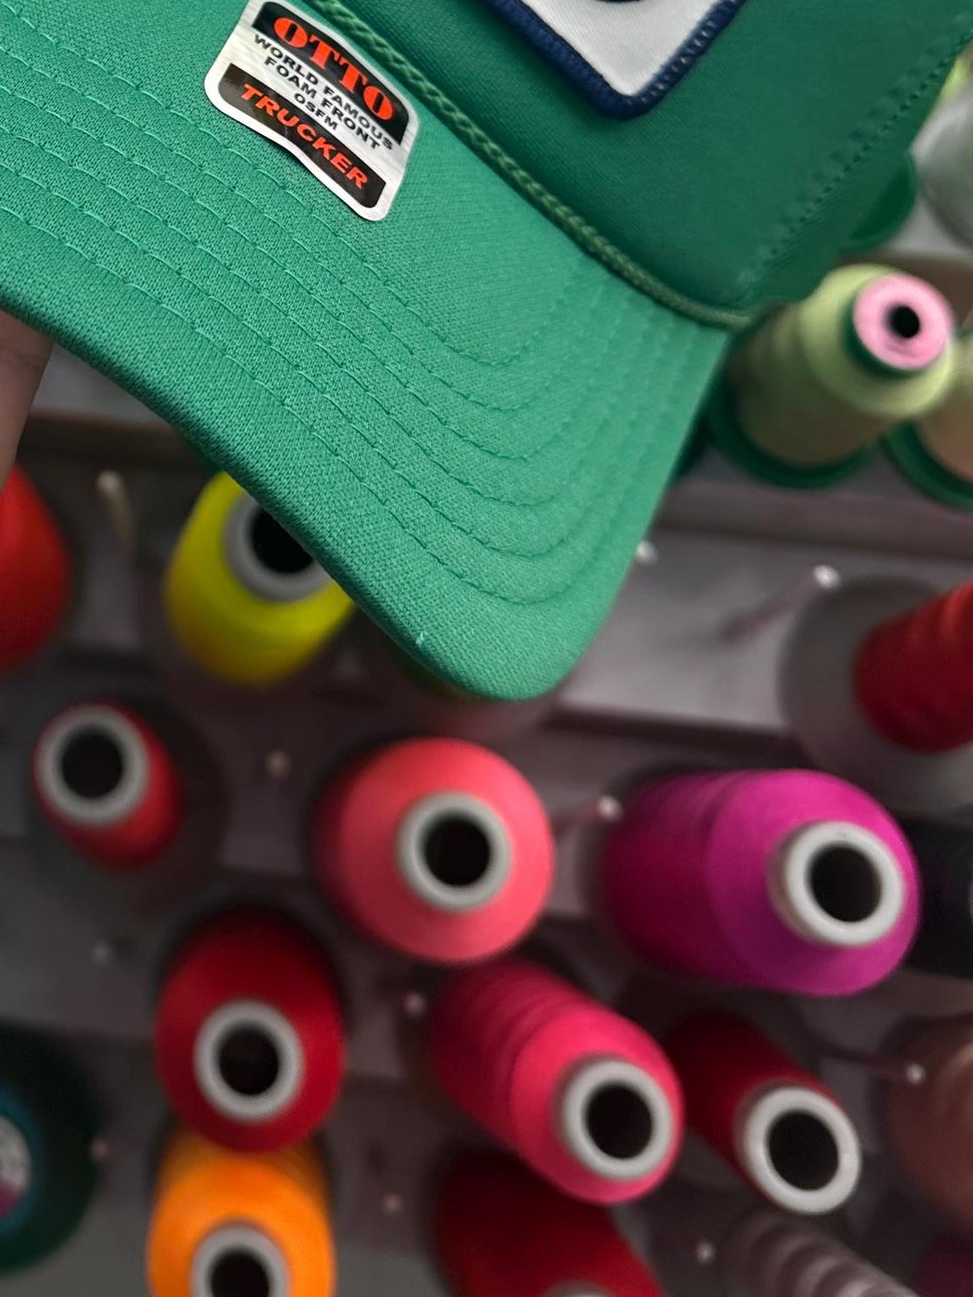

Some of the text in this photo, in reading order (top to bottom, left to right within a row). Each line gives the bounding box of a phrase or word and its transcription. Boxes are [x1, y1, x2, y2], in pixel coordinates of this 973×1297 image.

[254, 33, 394, 151] WORLD FAMOUS
[264, 56, 381, 150] FOAM FRONT
[273, 16, 394, 121] OTTO
[294, 93, 339, 131] OSFM
[241, 83, 369, 190] TRUCKER
